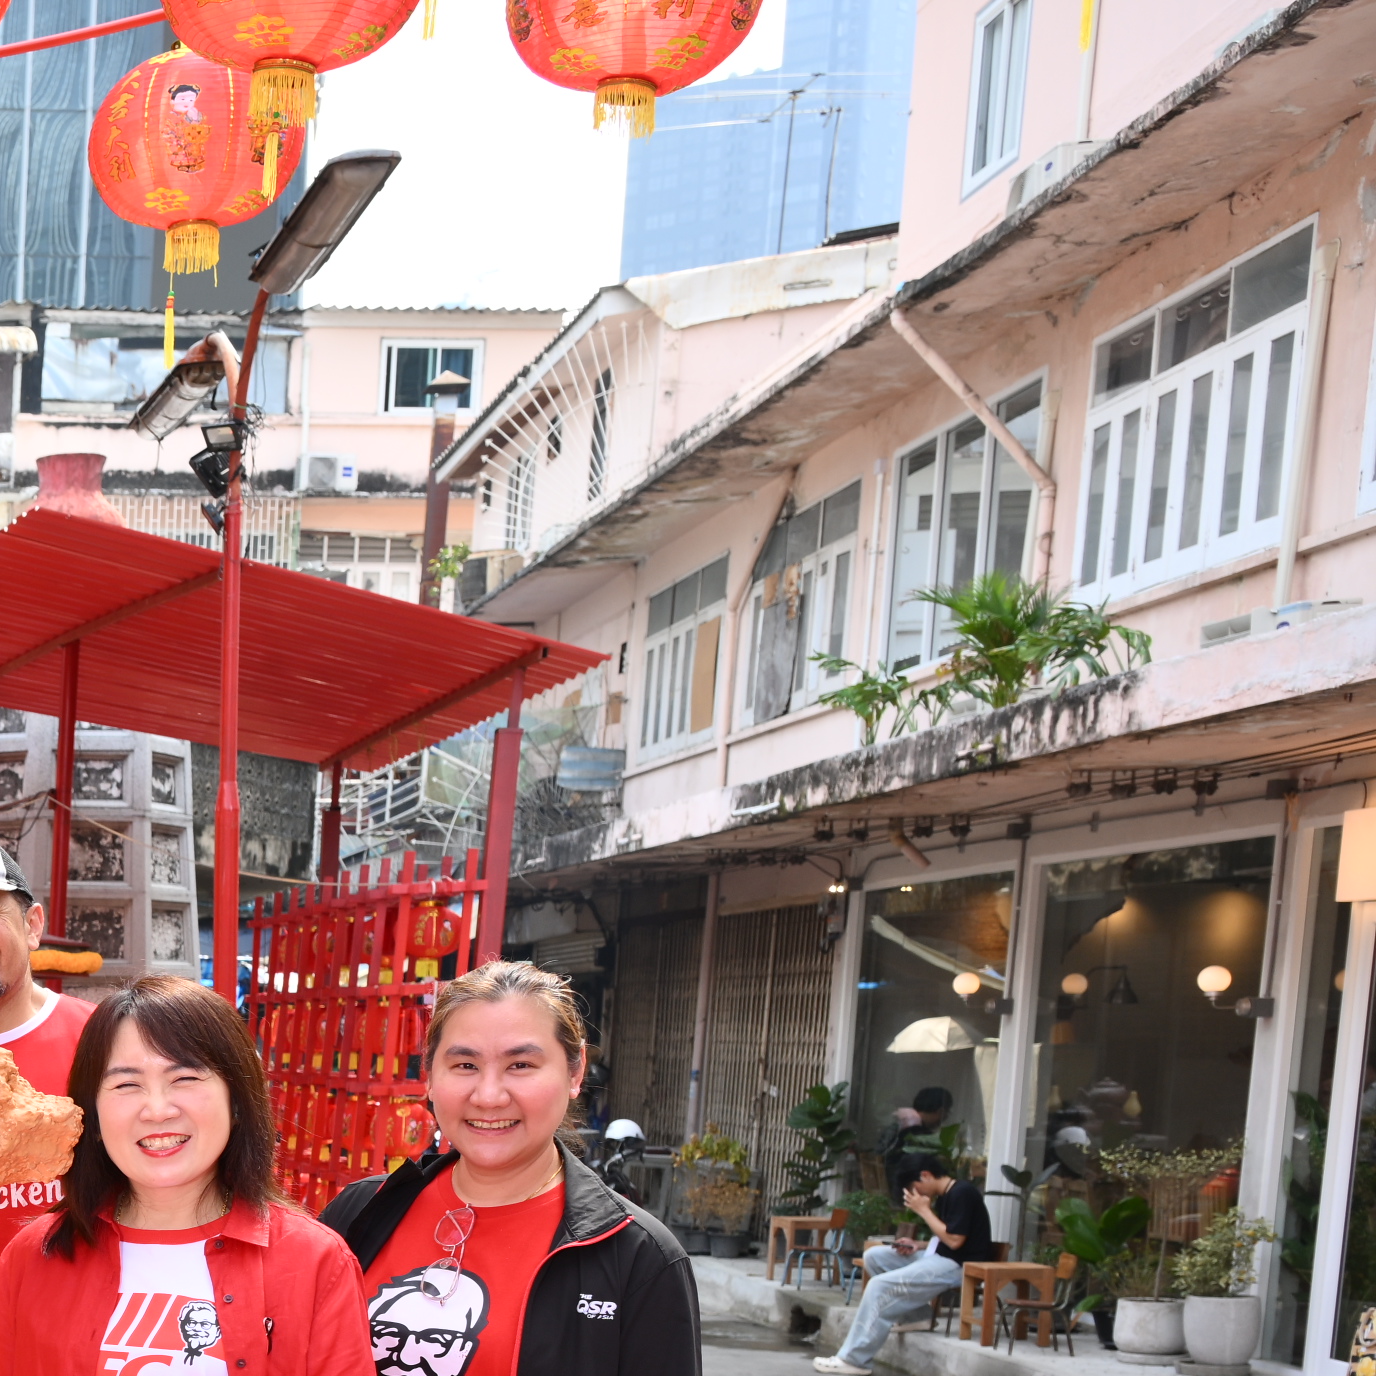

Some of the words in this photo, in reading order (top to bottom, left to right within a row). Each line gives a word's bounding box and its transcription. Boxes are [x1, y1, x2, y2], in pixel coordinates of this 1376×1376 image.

[105, 69, 142, 183] 大吉大利
[576, 1299, 618, 1315] QSR
